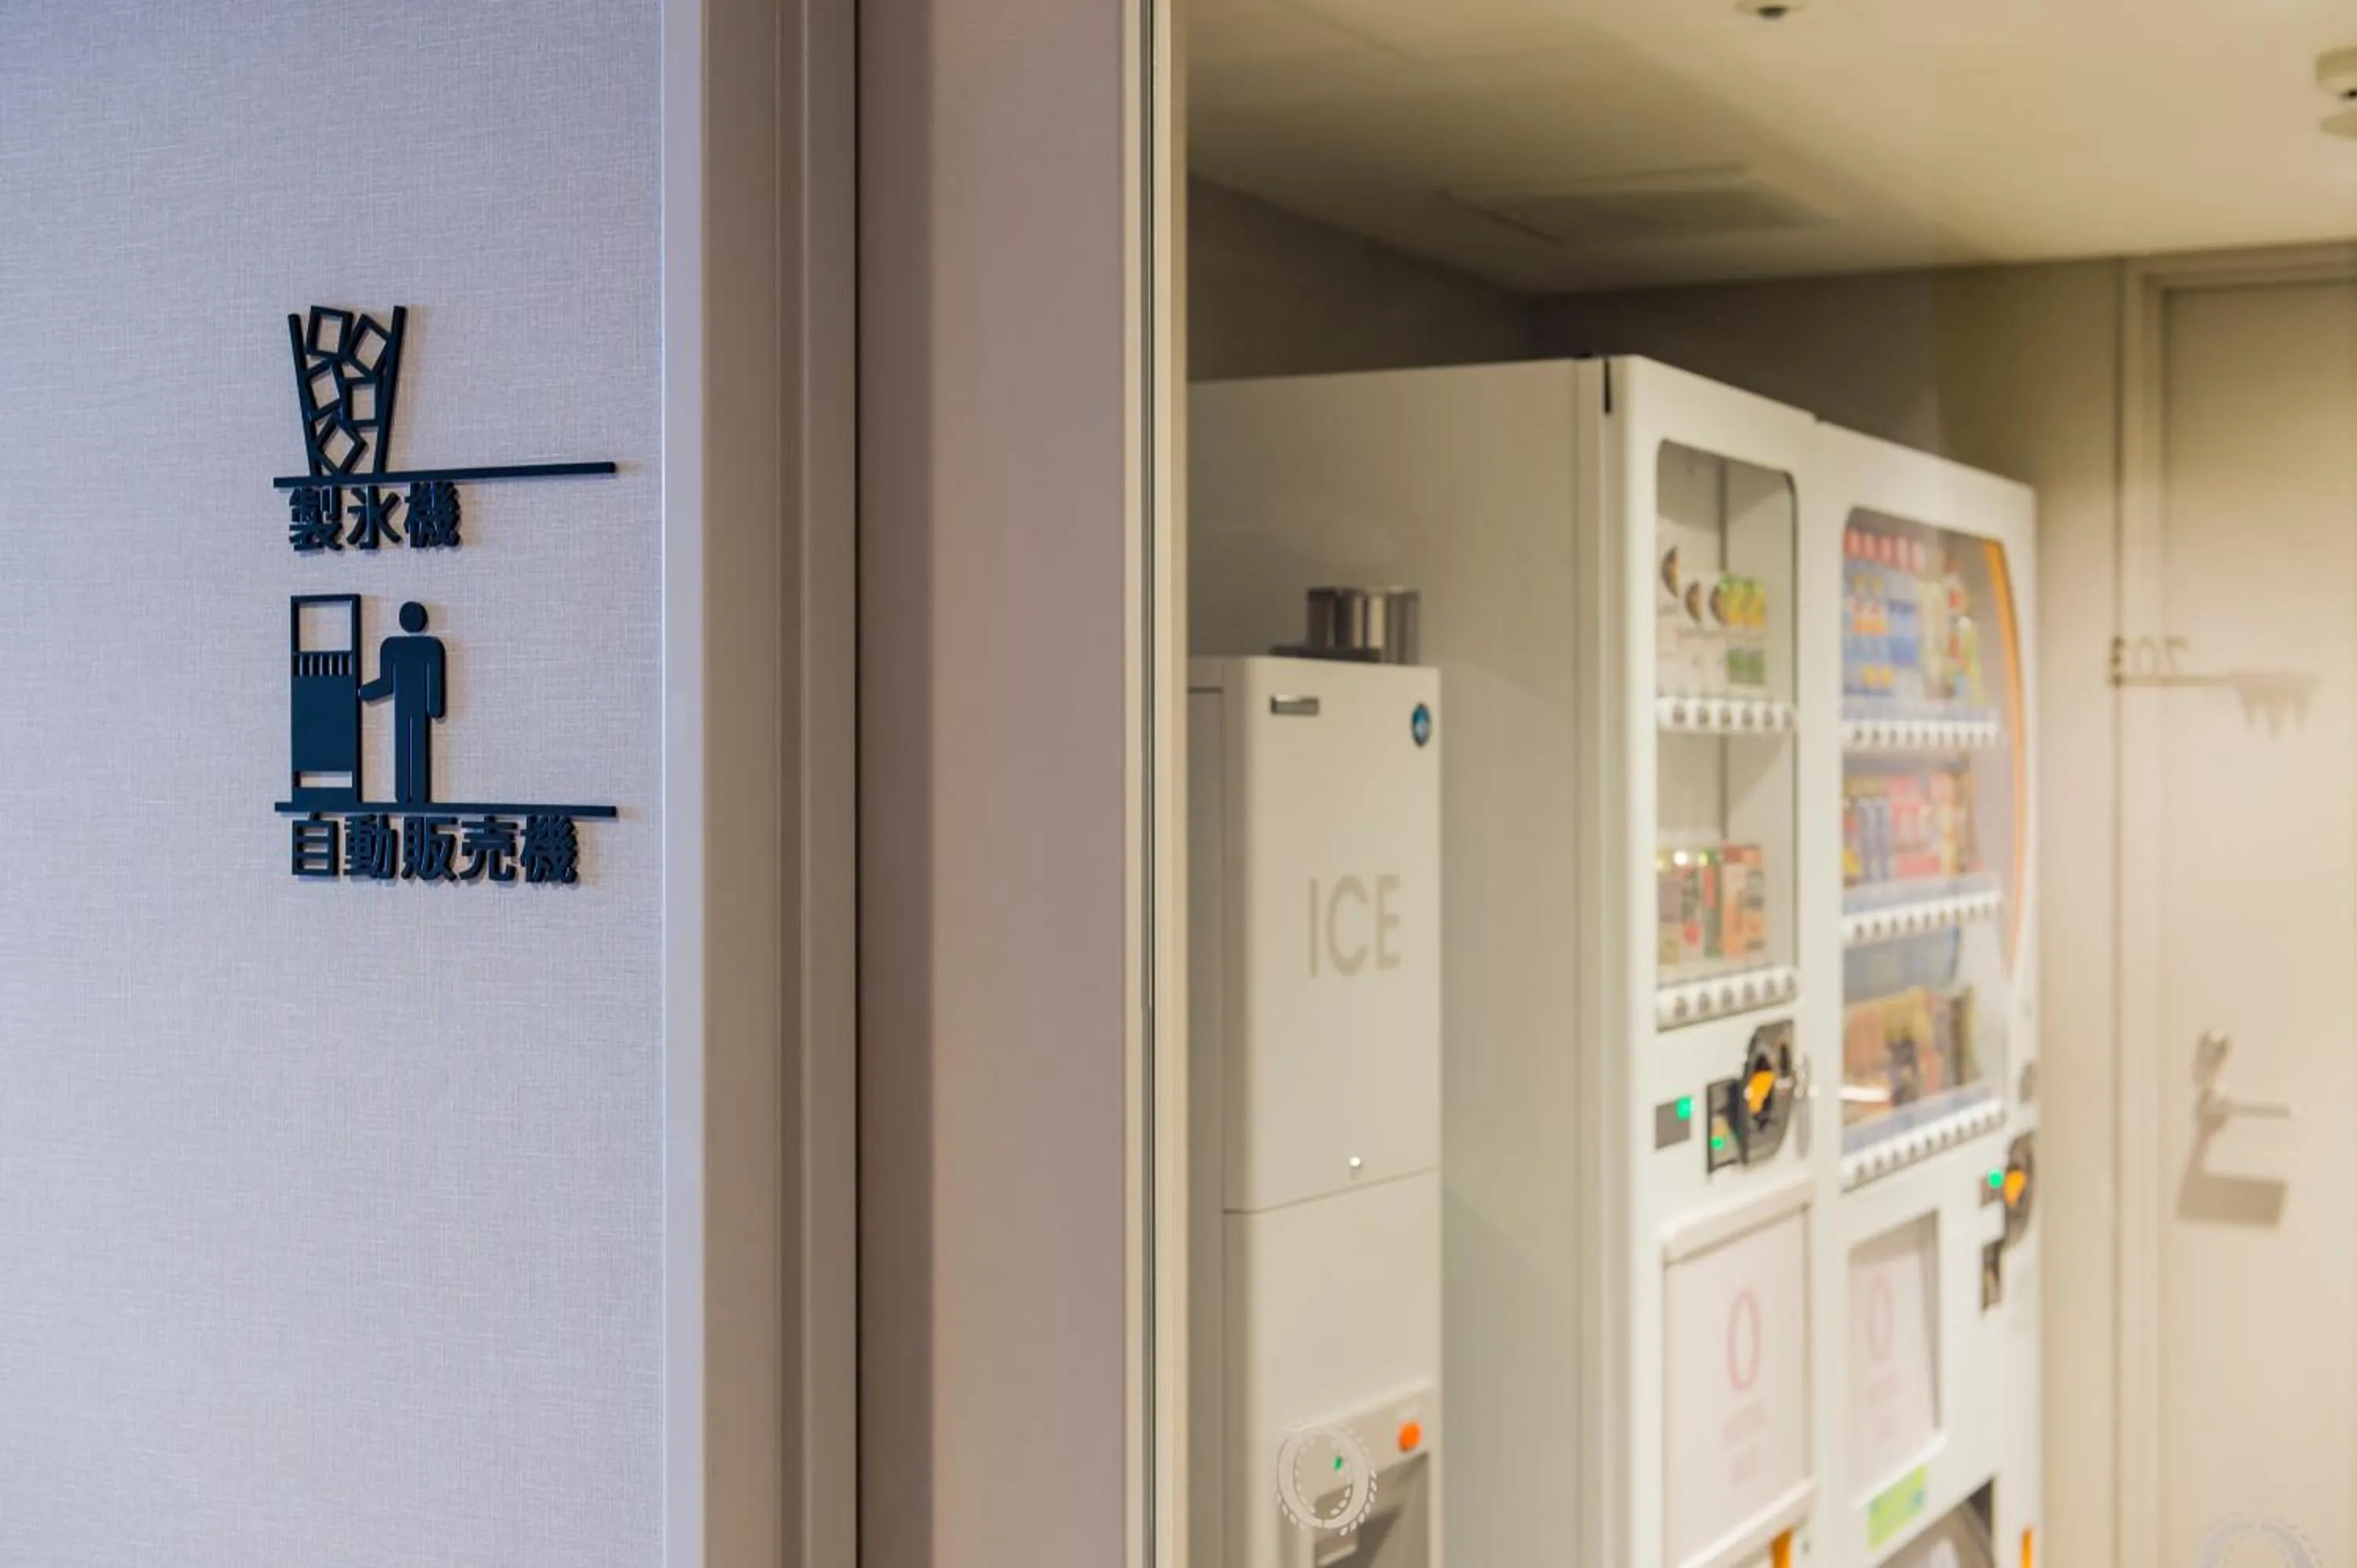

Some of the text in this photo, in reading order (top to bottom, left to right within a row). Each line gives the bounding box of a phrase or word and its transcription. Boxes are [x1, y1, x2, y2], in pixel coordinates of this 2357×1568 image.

[288, 481, 461, 551] 製氷機
[291, 812, 579, 885] 自動販売機
[1310, 874, 1402, 977] ICE
